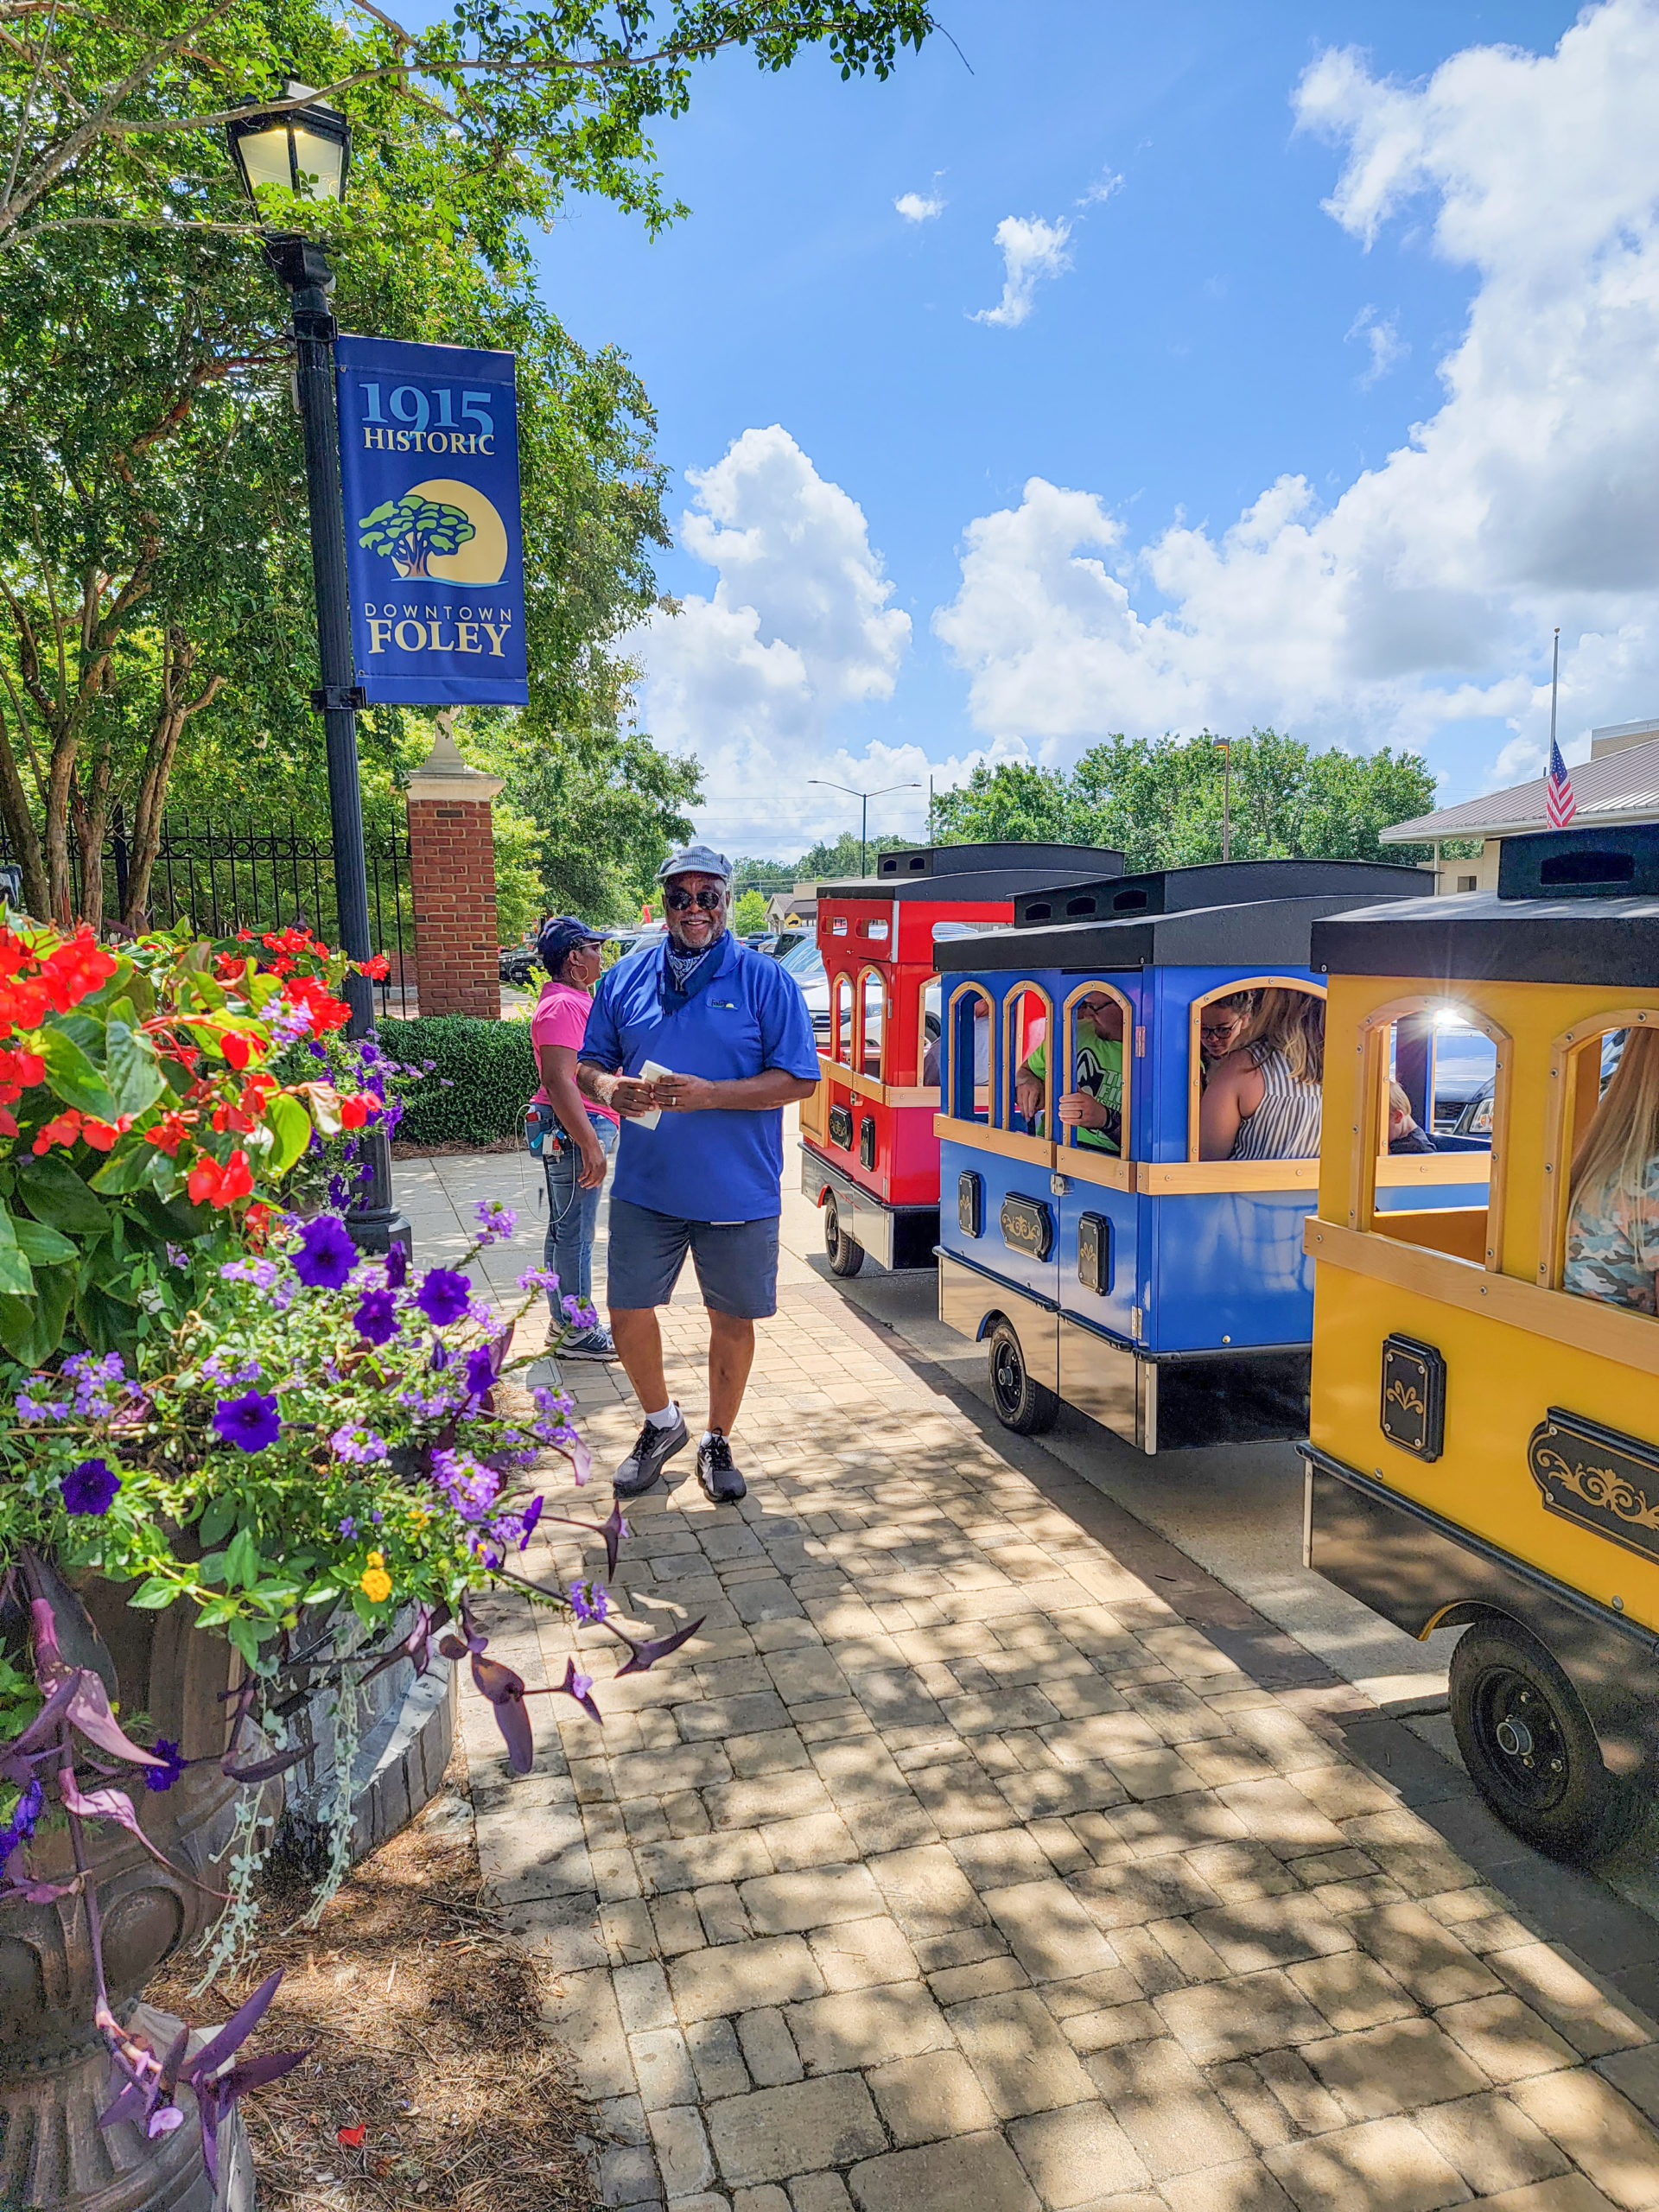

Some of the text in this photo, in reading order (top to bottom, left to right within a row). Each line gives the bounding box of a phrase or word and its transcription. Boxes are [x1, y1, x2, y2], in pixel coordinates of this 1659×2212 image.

[359, 383, 494, 446] 1915
[362, 427, 495, 455] HISTORIC
[364, 602, 512, 622] DOWNTOWN
[365, 619, 512, 658] FOLEY
